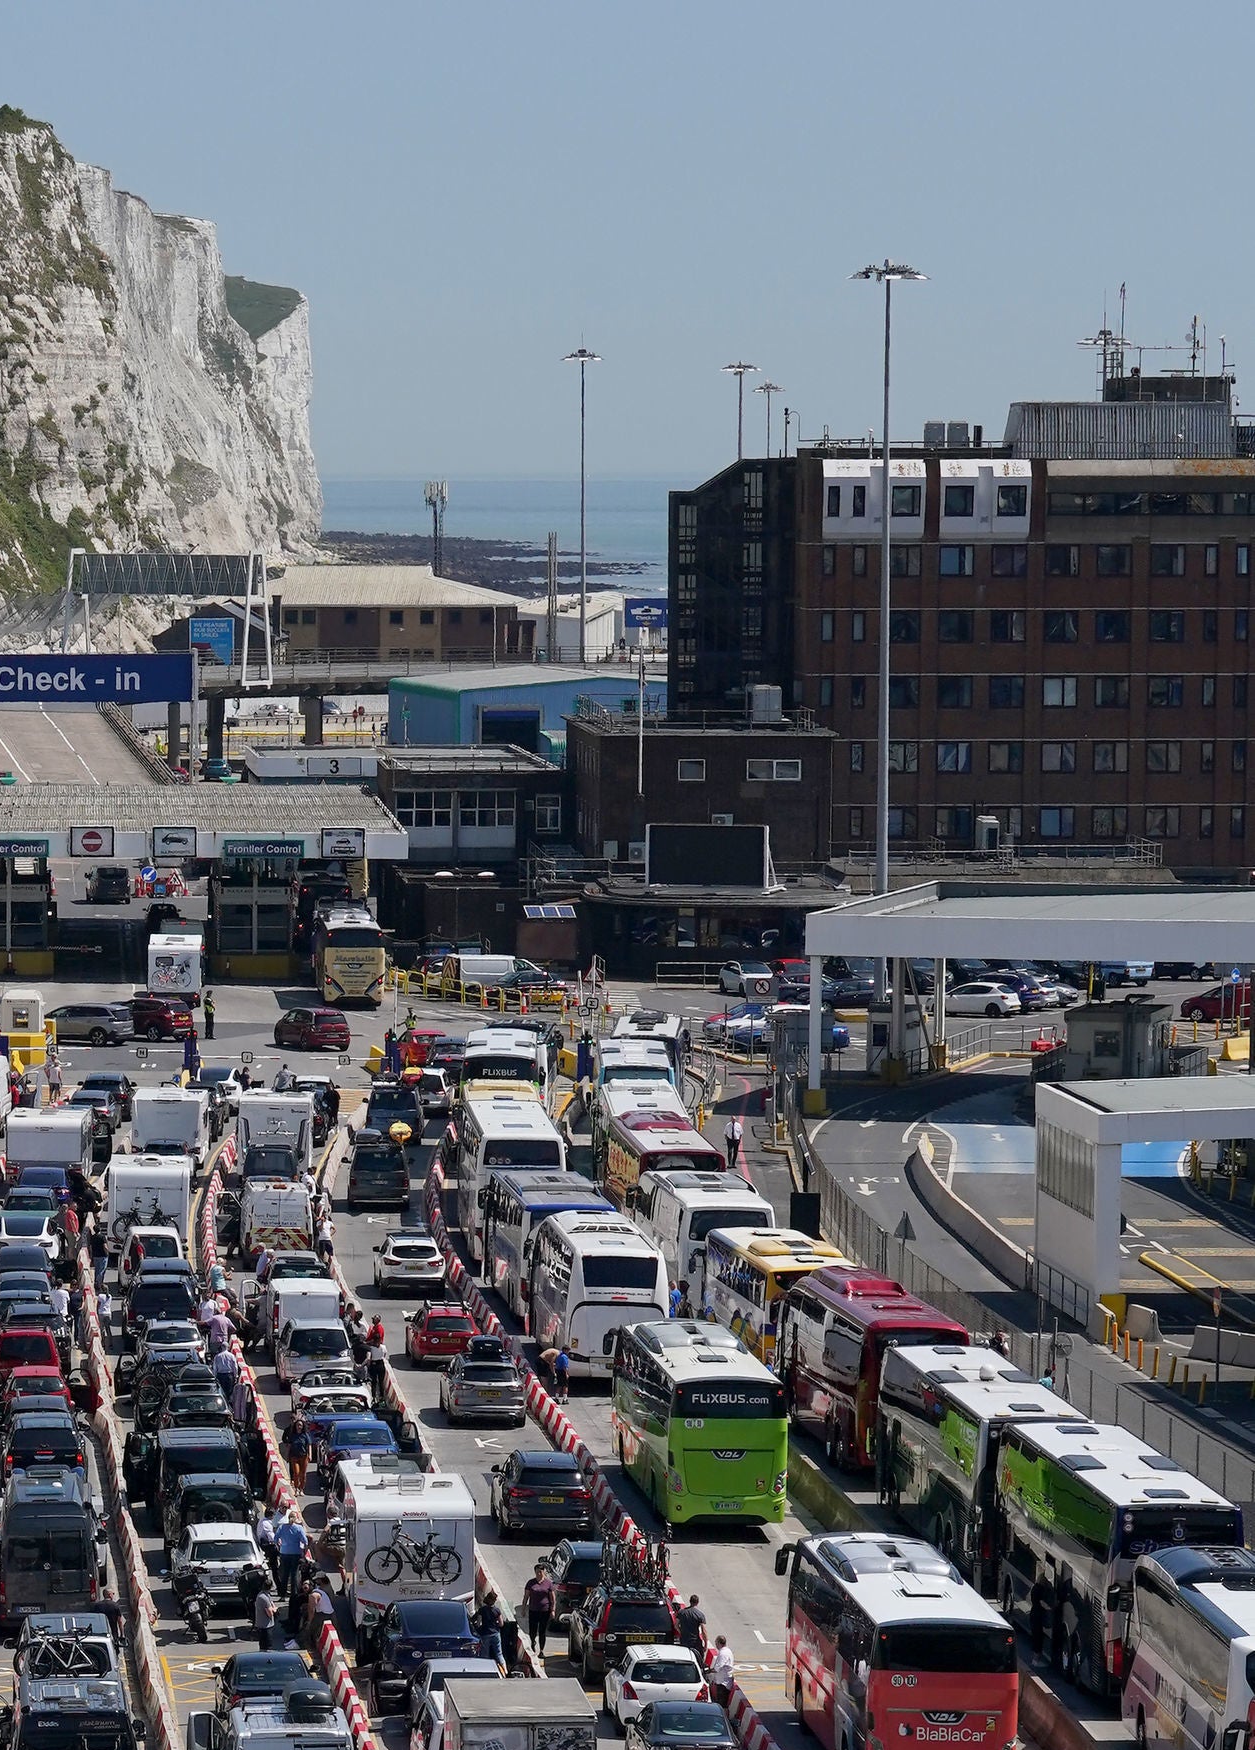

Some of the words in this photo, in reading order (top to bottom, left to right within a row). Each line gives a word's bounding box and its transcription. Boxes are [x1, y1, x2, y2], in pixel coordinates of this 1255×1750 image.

[114, 666, 141, 692] in
[329, 759, 340, 774] 3
[10, 844, 46, 854] Control
[227, 844, 264, 854] Frontier
[265, 844, 302, 854] Control
[716, 1450, 739, 1459] VDL
[929, 1713, 958, 1722] VDL
[916, 1728, 987, 1743] BlaBlaCar
